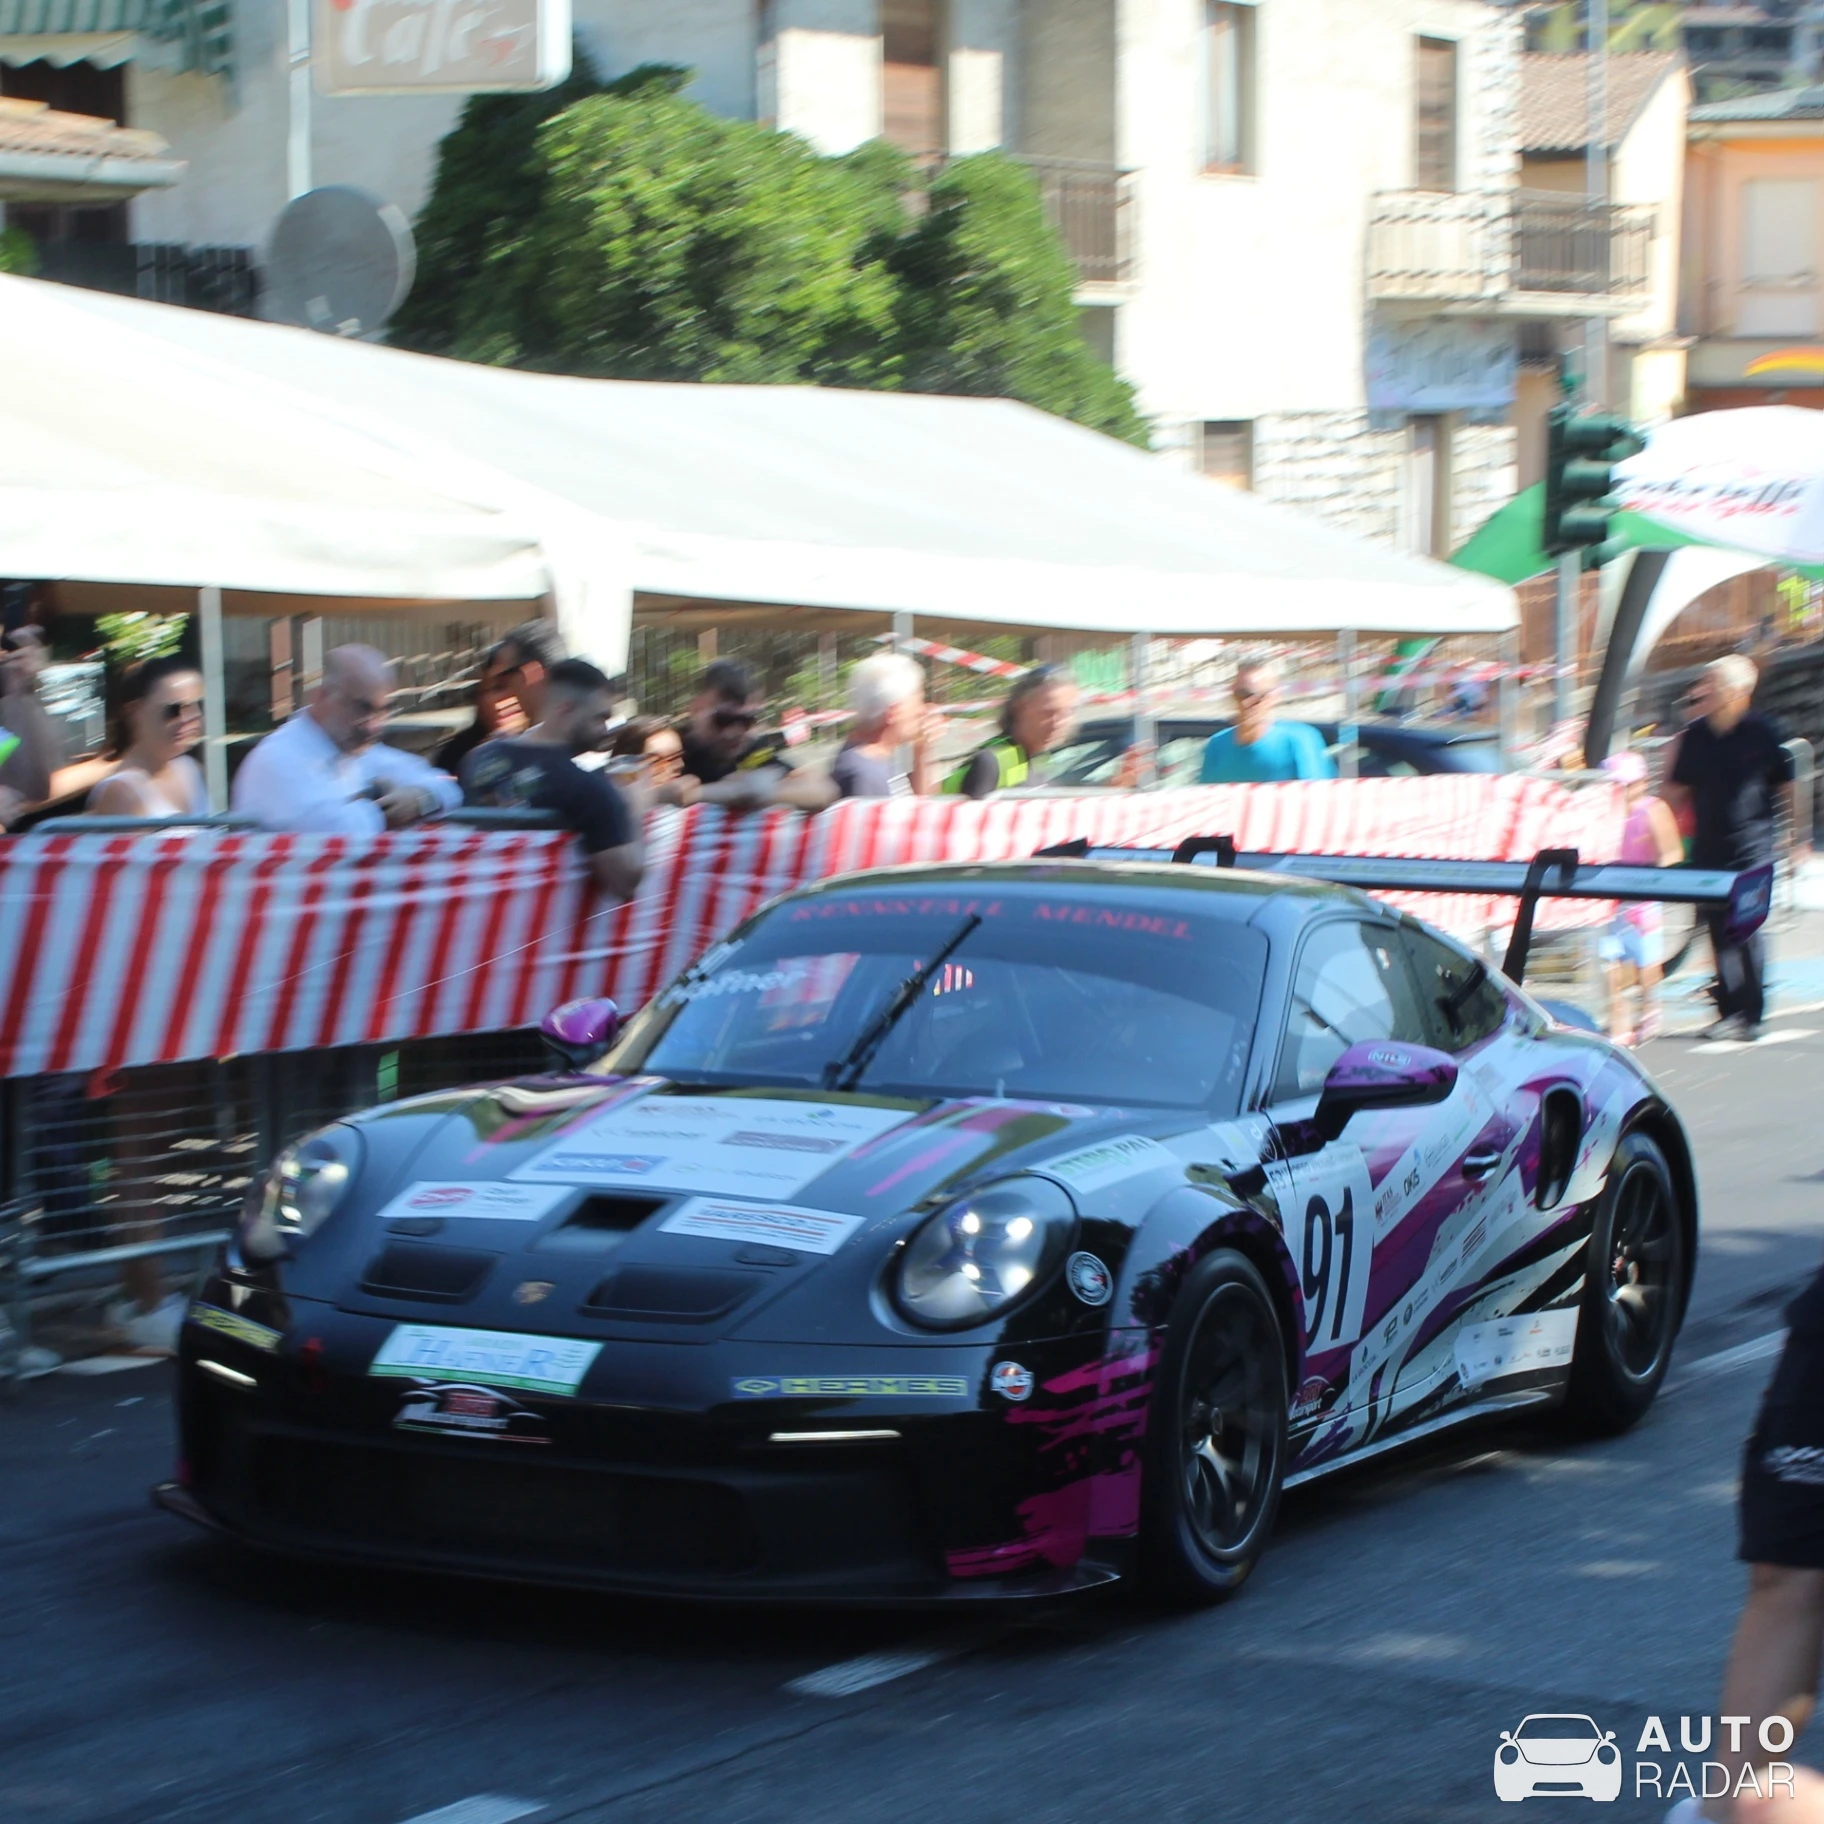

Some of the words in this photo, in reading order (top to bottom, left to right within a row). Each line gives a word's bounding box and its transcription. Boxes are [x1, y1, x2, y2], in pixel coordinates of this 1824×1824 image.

[791, 898, 1007, 921] RENNSTALL
[1033, 902, 1194, 941] MENDEL
[1302, 1186, 1354, 1350] 91
[782, 1376, 968, 1396] HERMES
